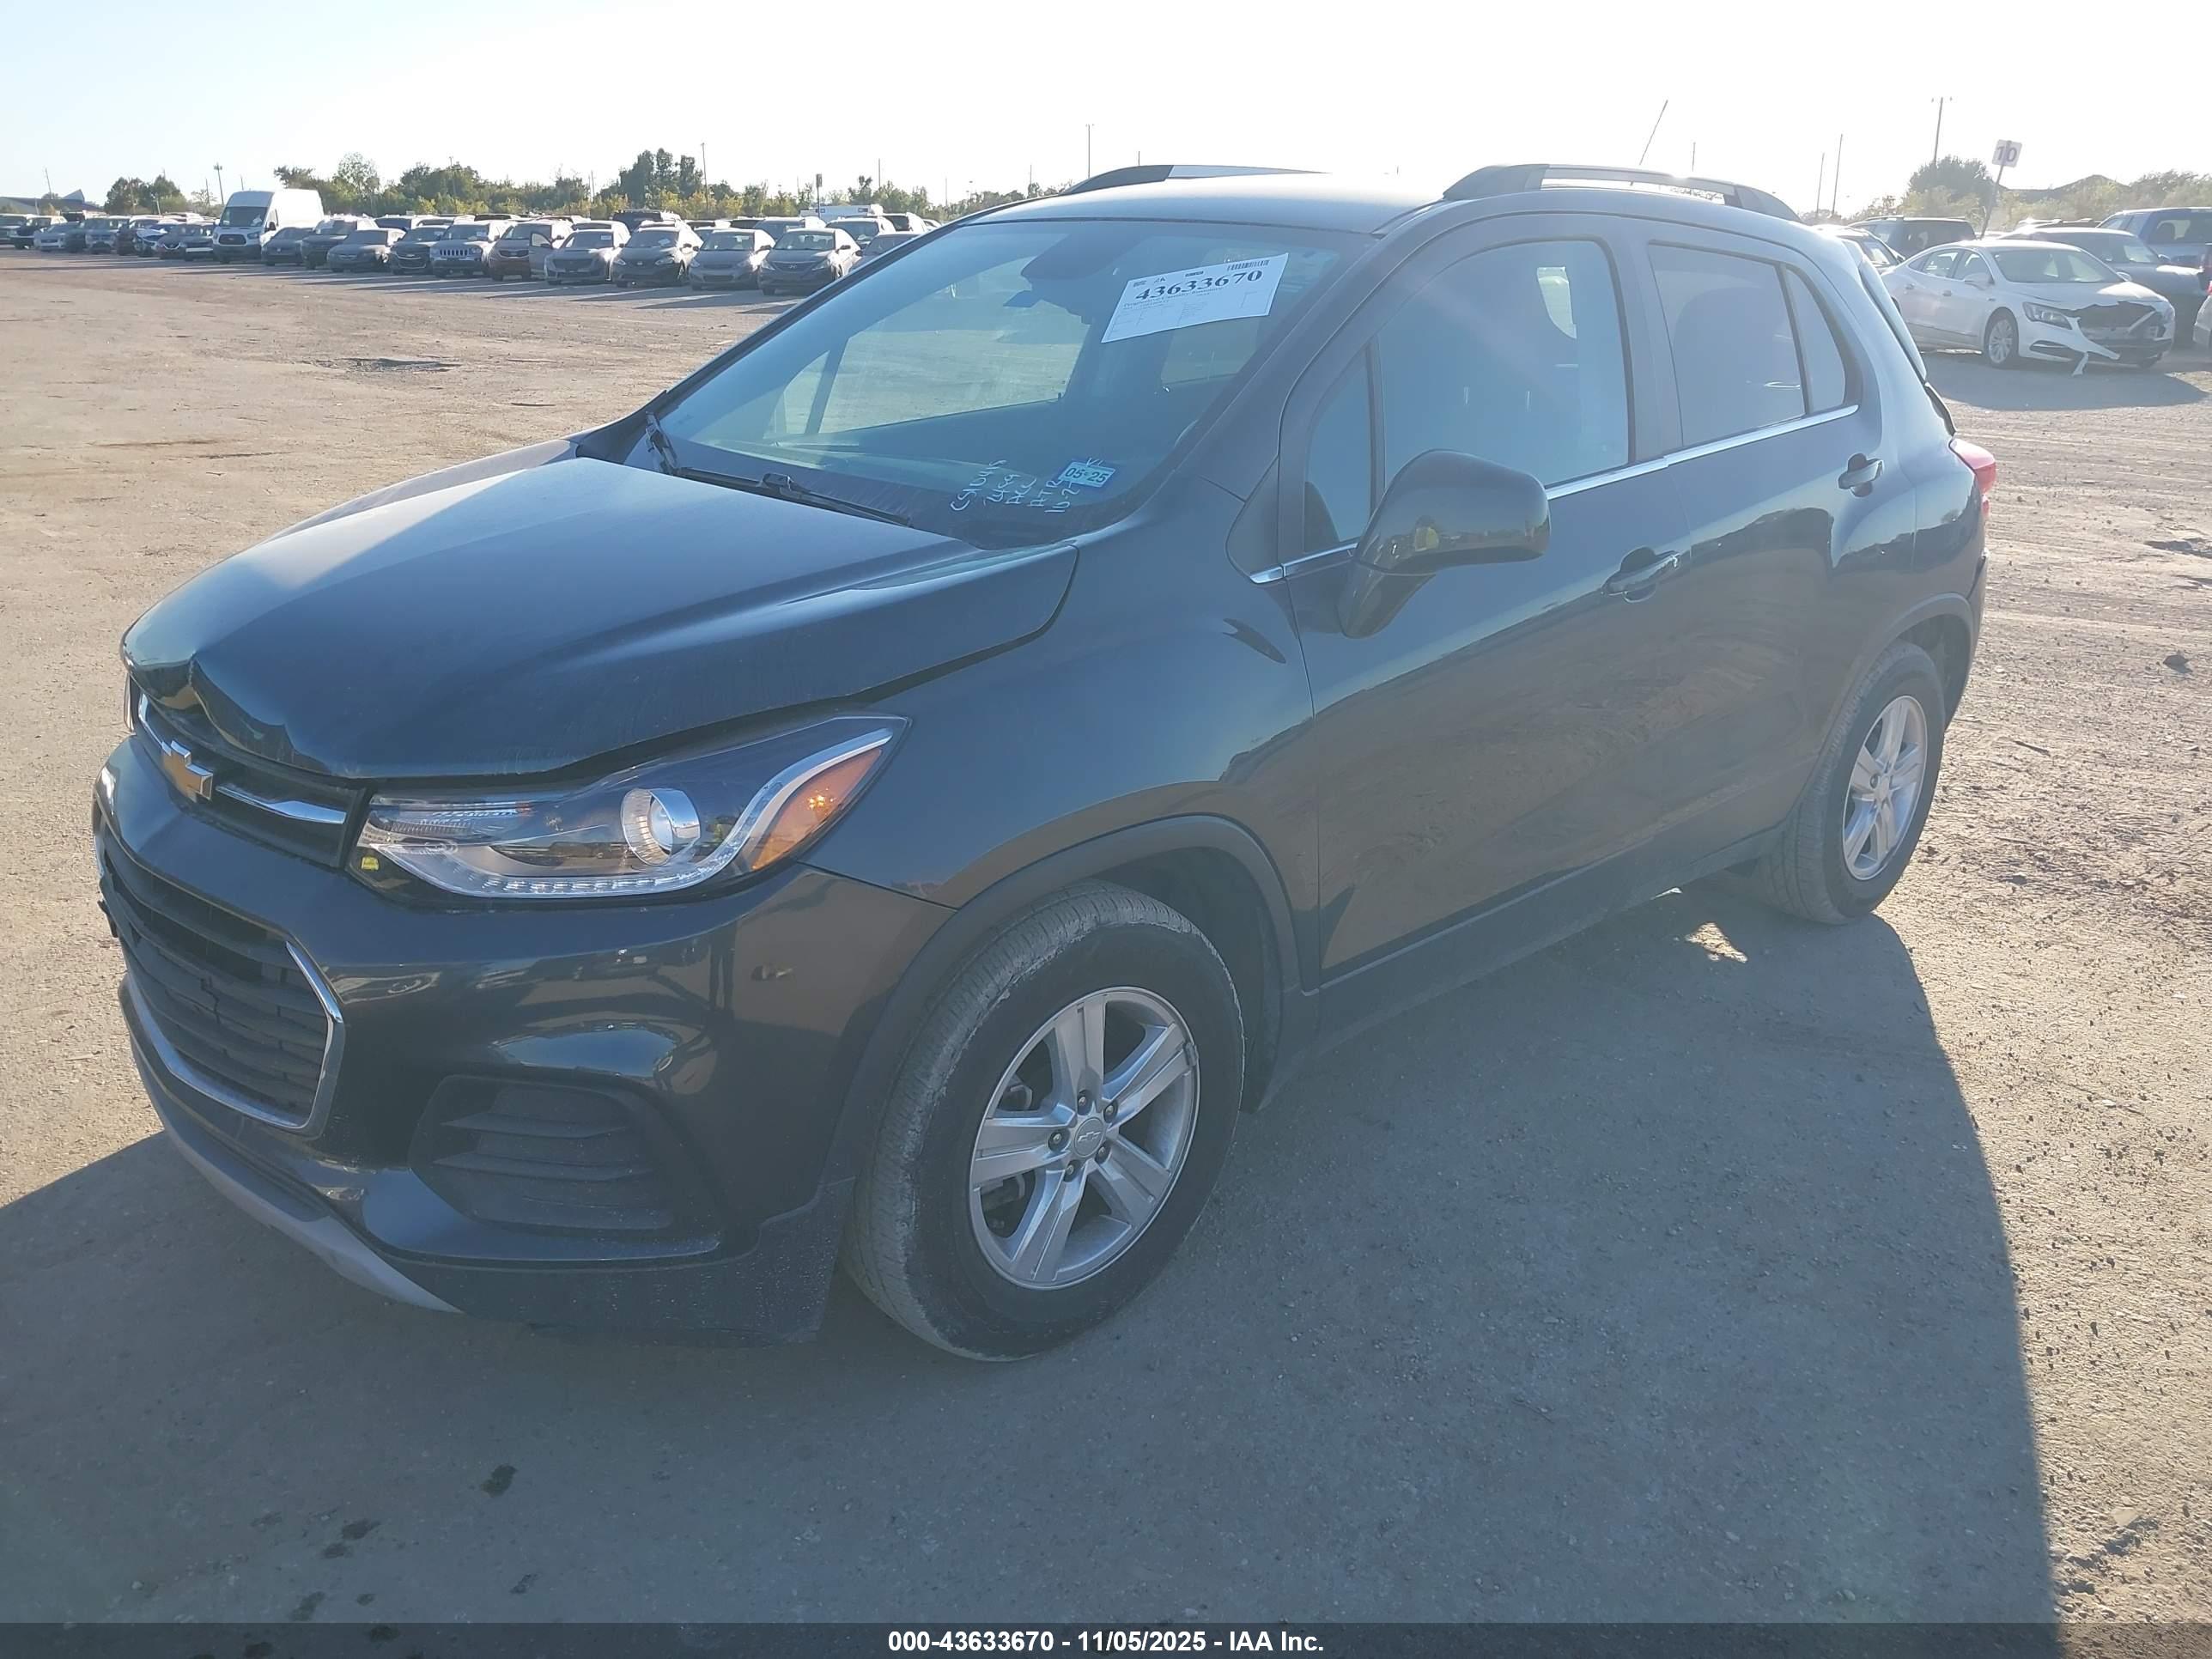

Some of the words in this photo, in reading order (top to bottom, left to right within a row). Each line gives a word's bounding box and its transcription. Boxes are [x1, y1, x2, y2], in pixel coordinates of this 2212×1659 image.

[1997, 147, 2018, 161] 10
[1134, 270, 1264, 301] 43633670
[1065, 467, 1085, 478] 05
[1086, 471, 1109, 483] 25
